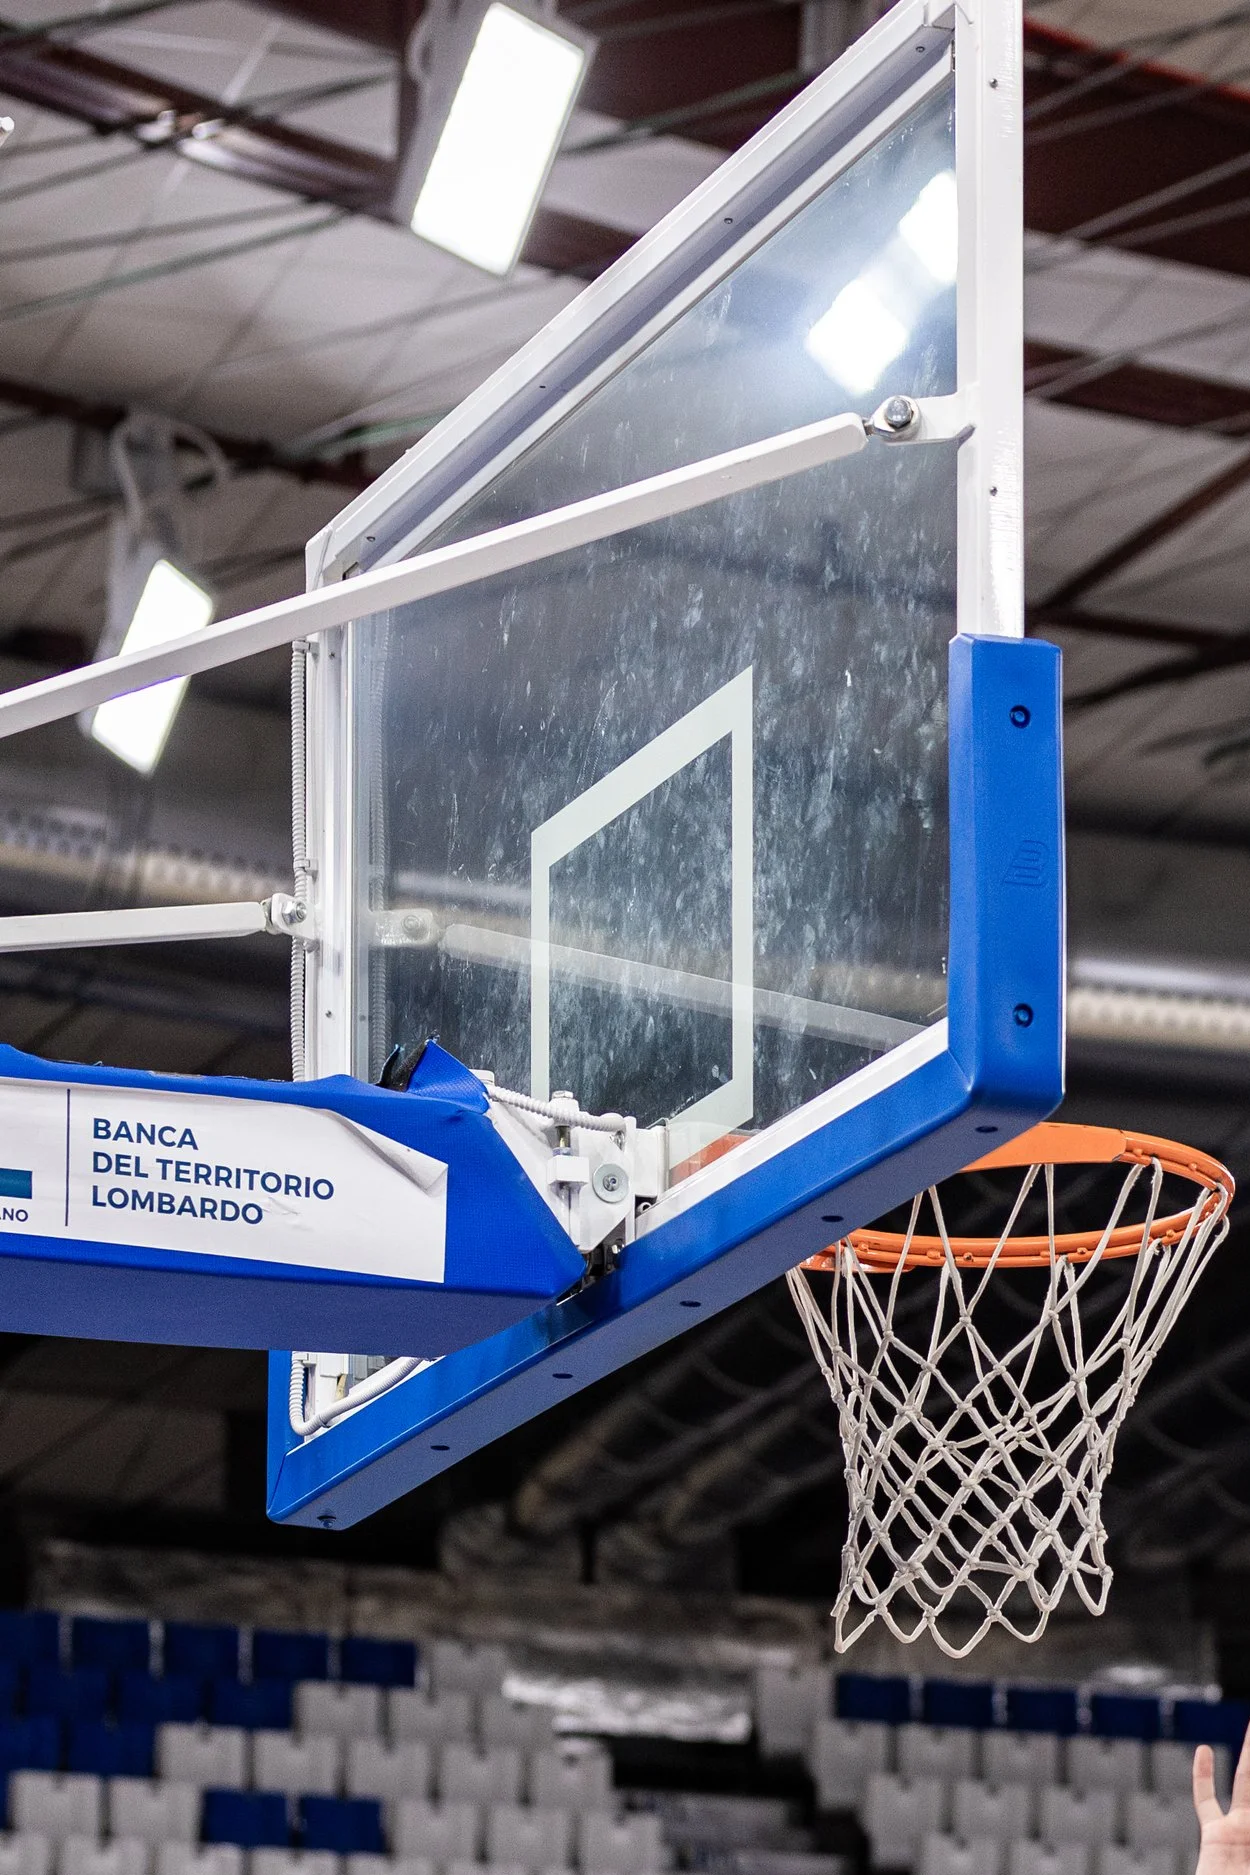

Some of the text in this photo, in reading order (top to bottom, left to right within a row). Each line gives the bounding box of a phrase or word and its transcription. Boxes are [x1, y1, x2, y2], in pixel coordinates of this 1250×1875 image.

[92, 1117, 199, 1151] BANCA
[92, 1152, 335, 1201] DEL TERRITORIO
[0, 1207, 29, 1222] NO
[91, 1185, 264, 1225] LOMBARDO
